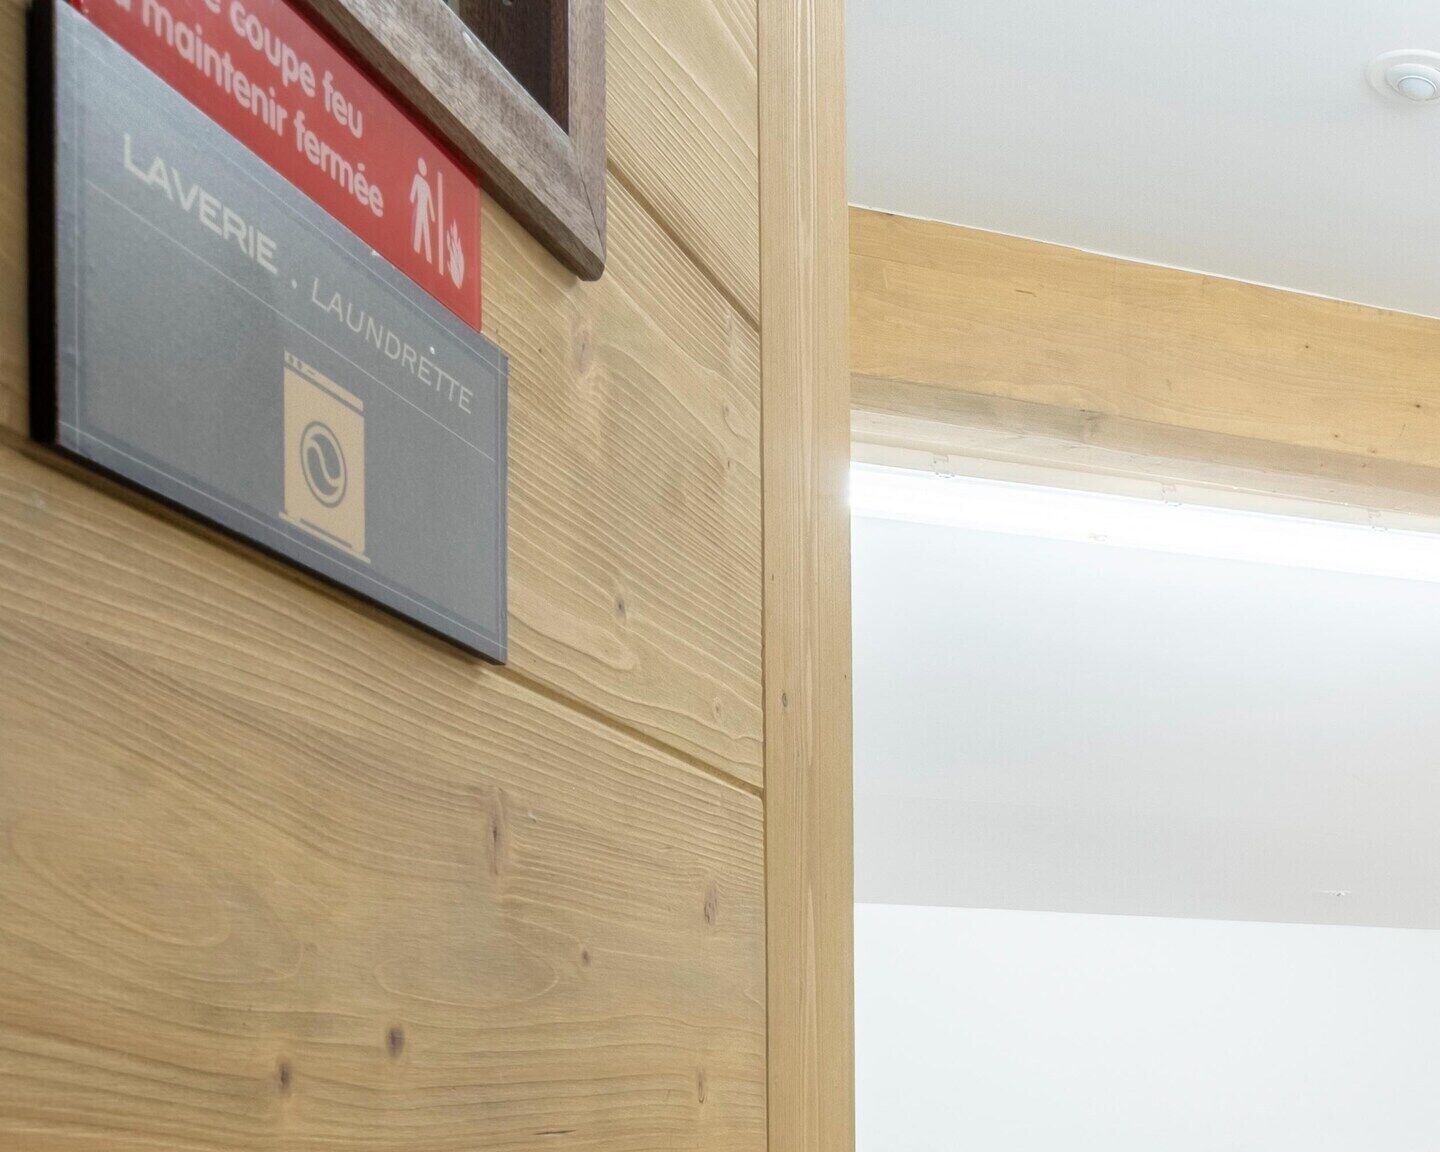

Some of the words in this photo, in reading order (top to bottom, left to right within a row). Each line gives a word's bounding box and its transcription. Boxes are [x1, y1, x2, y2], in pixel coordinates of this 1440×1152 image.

[141, 0, 288, 137] maintenir
[293, 109, 385, 217] fermée
[230, 1, 316, 97] coupe
[321, 70, 364, 139] feu
[123, 133, 279, 275] LAVERIE
[311, 277, 474, 415] LAUNDRETTE
